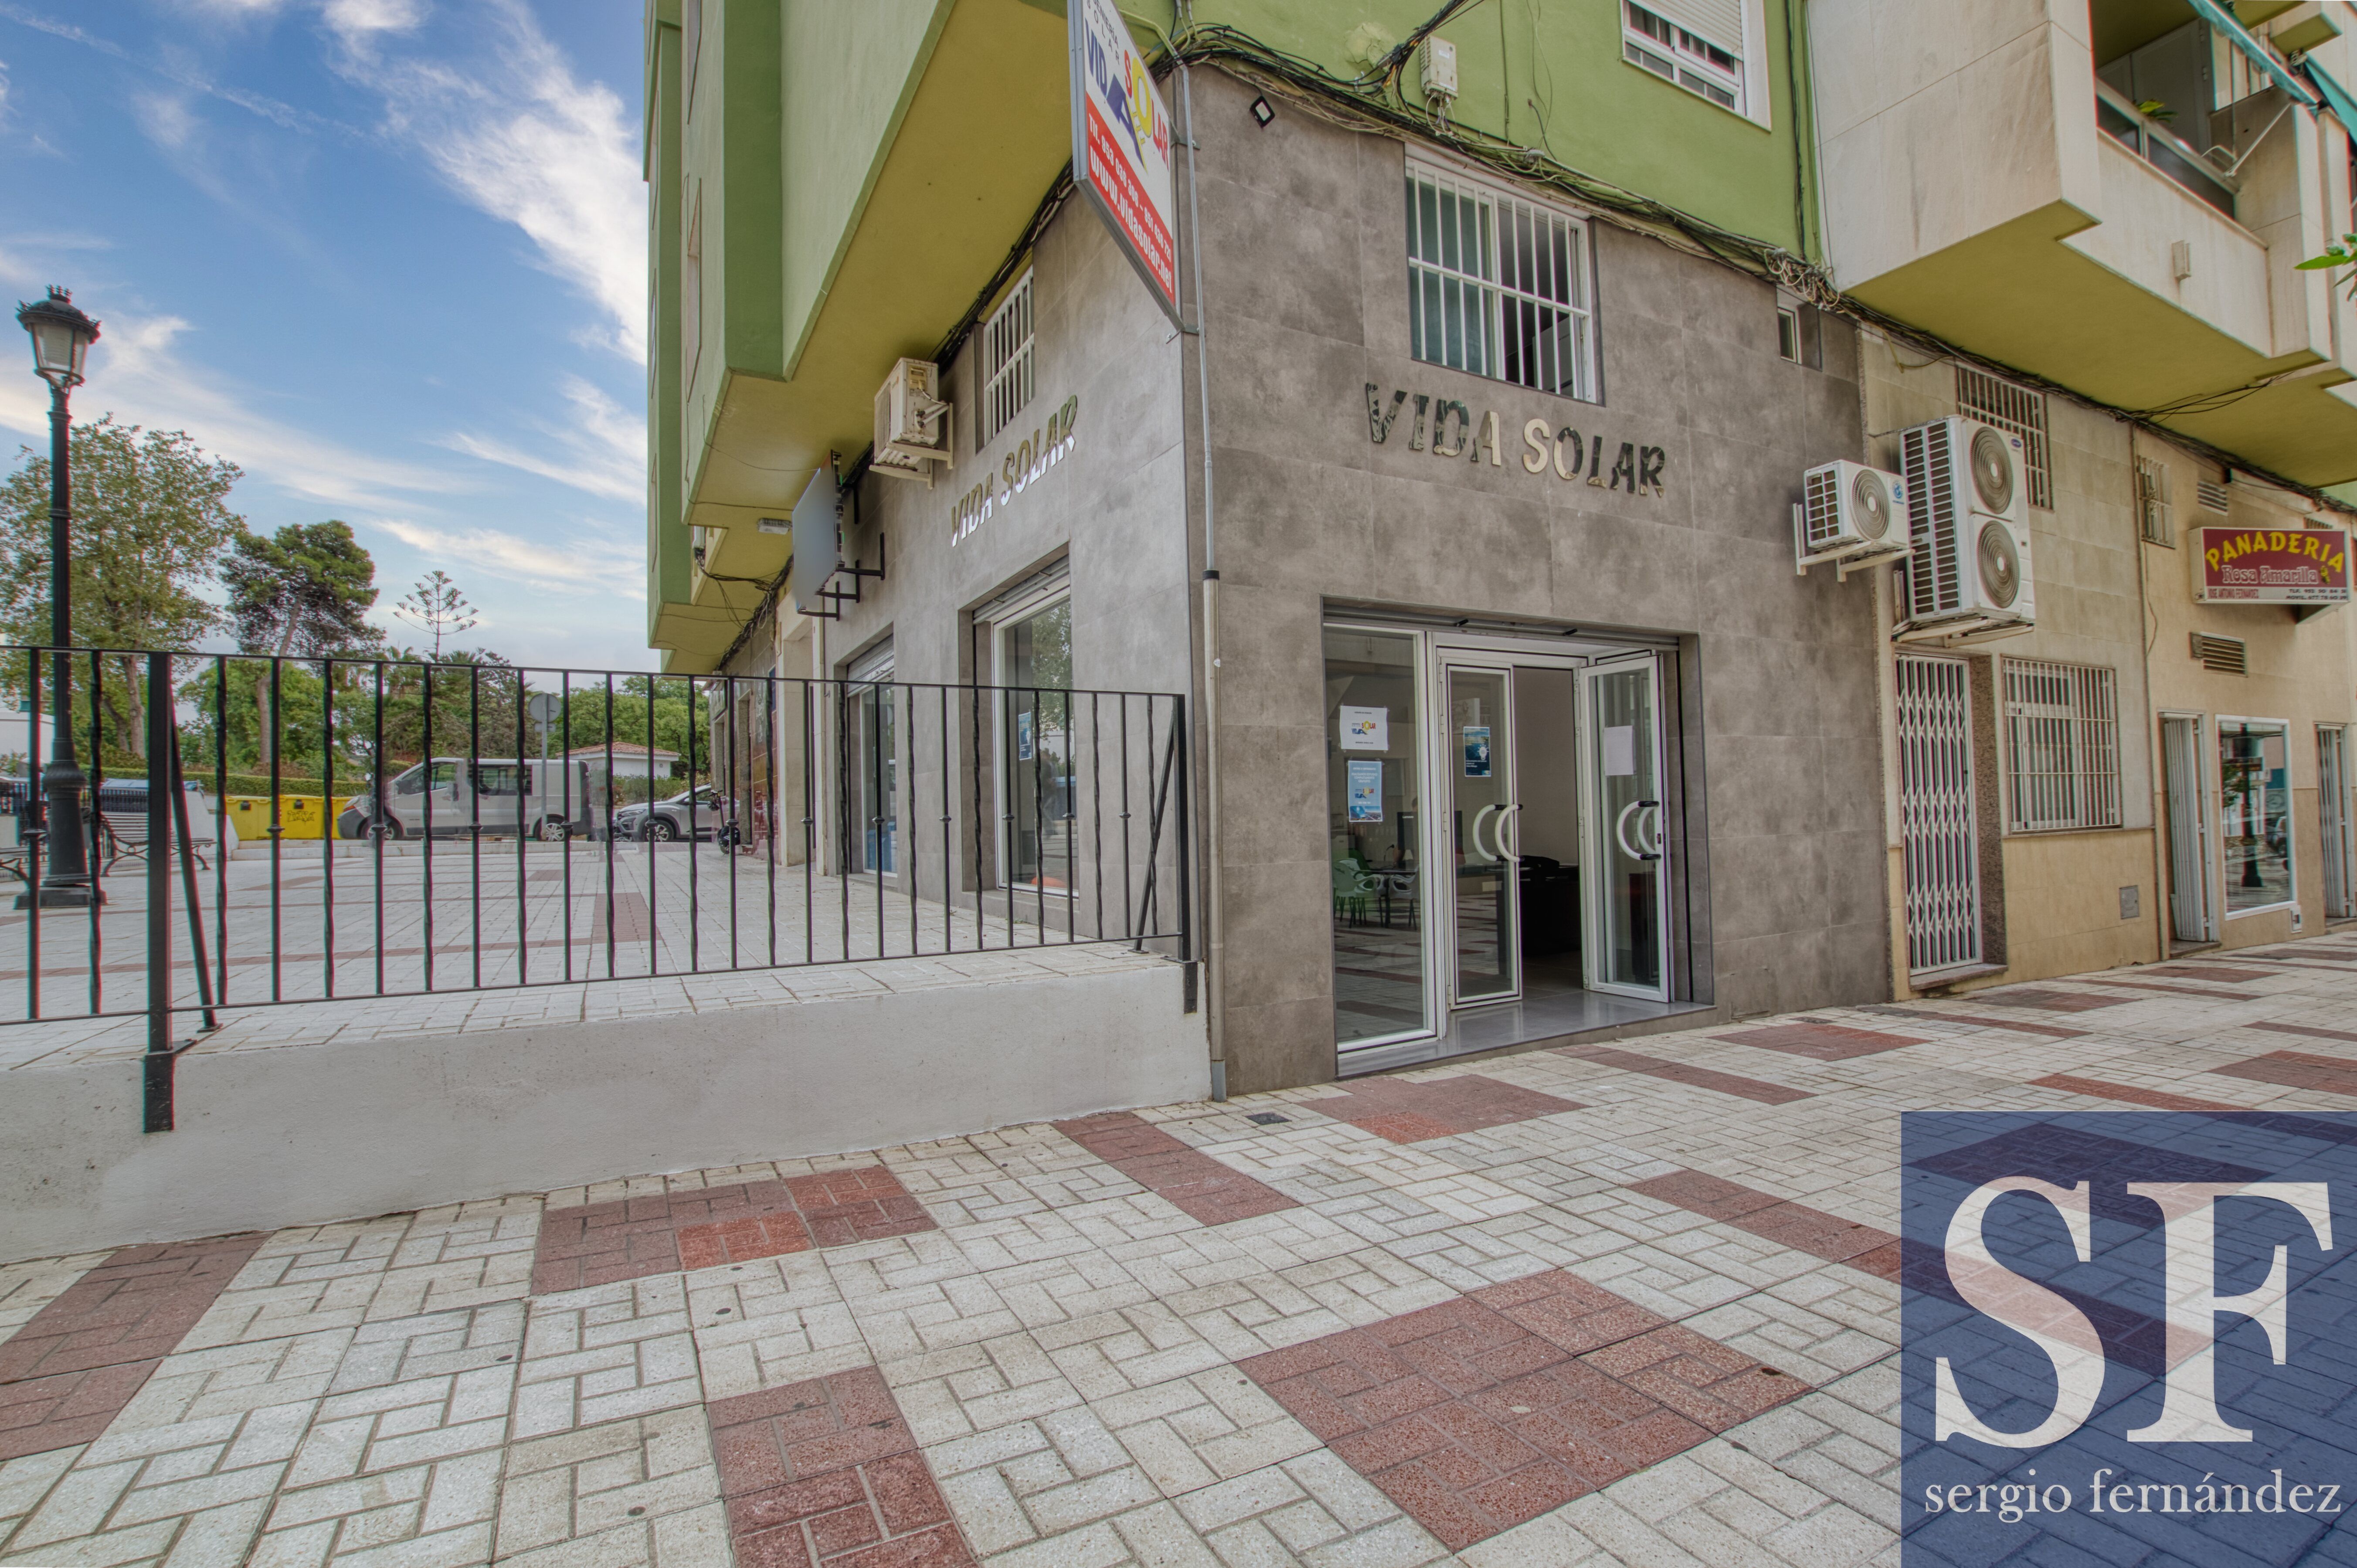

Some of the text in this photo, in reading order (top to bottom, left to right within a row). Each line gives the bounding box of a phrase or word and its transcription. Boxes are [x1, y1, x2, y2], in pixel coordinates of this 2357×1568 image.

[1084, 17, 1145, 169] VIDA
[1124, 49, 1169, 172] SOLAR
[1090, 145, 1172, 293] www.vidasolar.net
[951, 394, 1078, 547] VIDA SOLAR
[1365, 382, 1666, 497] VIDA SOLAR
[2205, 531, 2344, 573] PANADERIA
[2221, 565, 2319, 584] Rosa Amarilla
